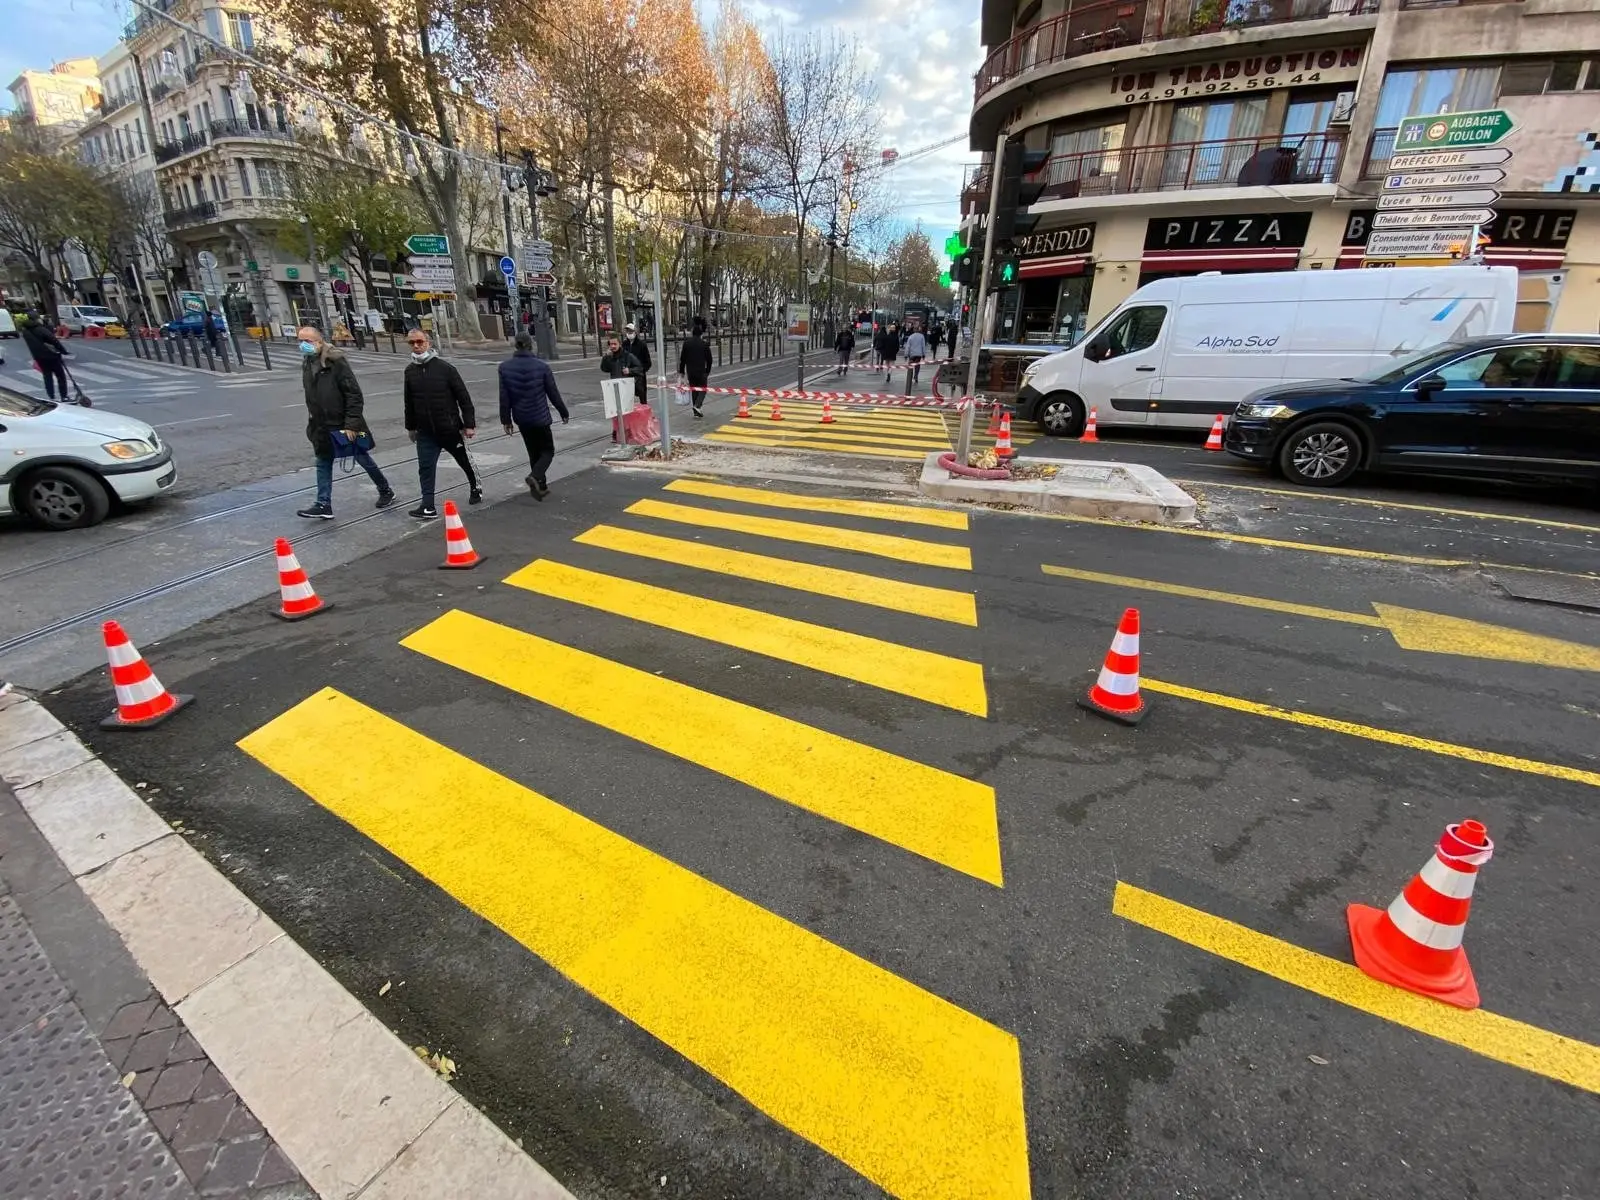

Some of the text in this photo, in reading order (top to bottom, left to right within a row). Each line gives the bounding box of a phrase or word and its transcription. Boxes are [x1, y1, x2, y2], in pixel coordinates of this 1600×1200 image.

[1169, 49, 1361, 86] TRADUCTION
[1125, 72, 1321, 103] 04.91.92.56.44
[1450, 115, 1502, 129] AUBAGNE
[1448, 128, 1493, 142] TOULON
[1394, 154, 1466, 167] PRÉFECTURE
[1403, 176, 1435, 185] Cours
[1442, 174, 1480, 183] Julien
[1382, 194, 1453, 206] Lycée Thiers
[1379, 212, 1482, 224] Théâtre des Bernardines
[1165, 219, 1281, 244] PIZZA
[1372, 230, 1468, 243] Conservatoire Nationa
[1377, 244, 1429, 254] rayonnement
[1196, 335, 1280, 350] Alpha Sud
